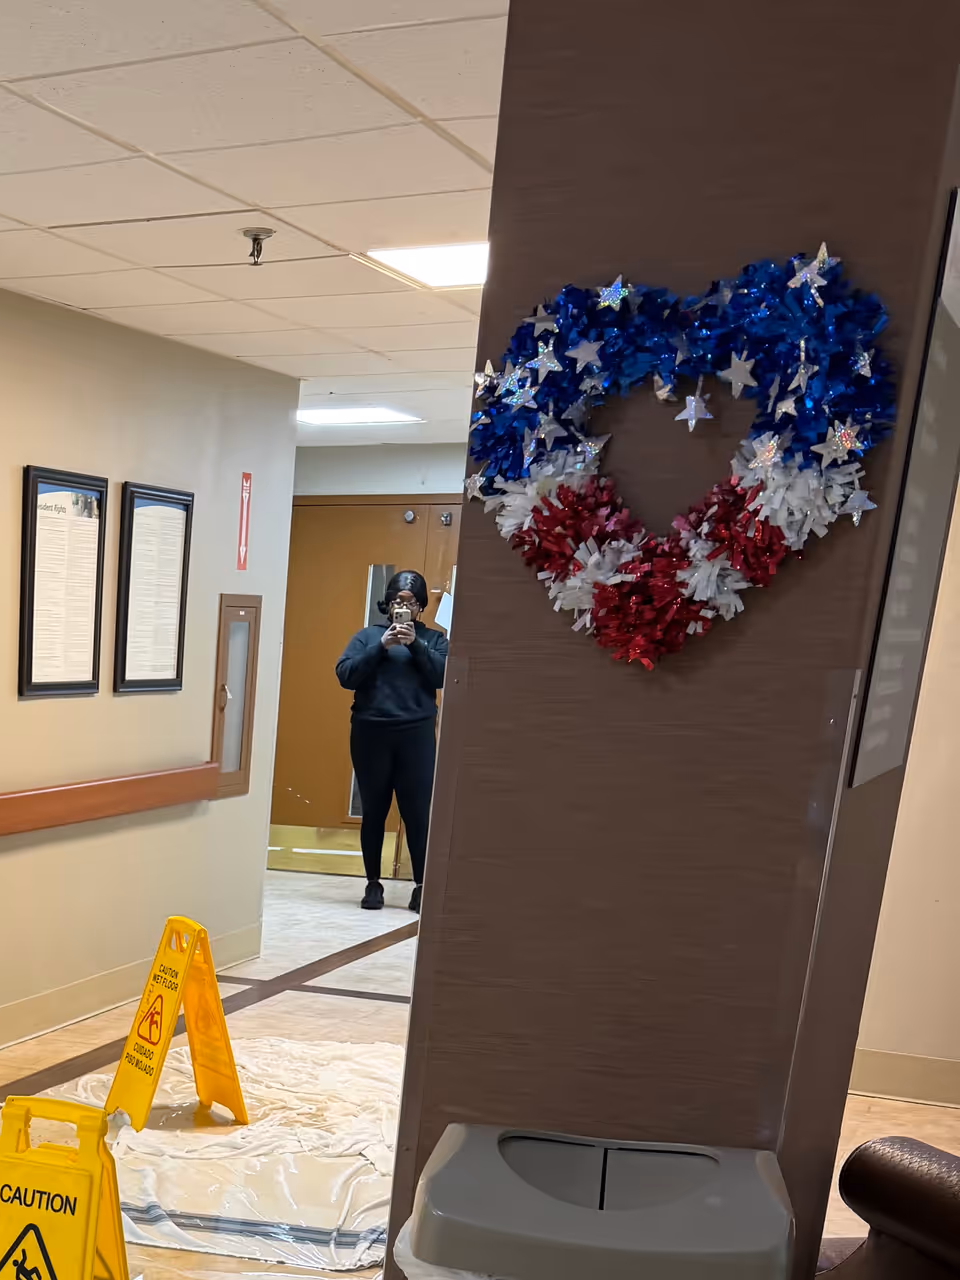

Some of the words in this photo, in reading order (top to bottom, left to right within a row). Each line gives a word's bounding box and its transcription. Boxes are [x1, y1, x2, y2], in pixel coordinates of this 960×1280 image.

[159, 964, 179, 979] CAUTION
[152, 973, 163, 984] WET
[161, 977, 179, 992] FLOOR
[133, 1042, 154, 1061] CUIDADO
[124, 1052, 136, 1066] PISO
[134, 1059, 154, 1077] MOJADO
[0, 1183, 78, 1216] CAUTION
